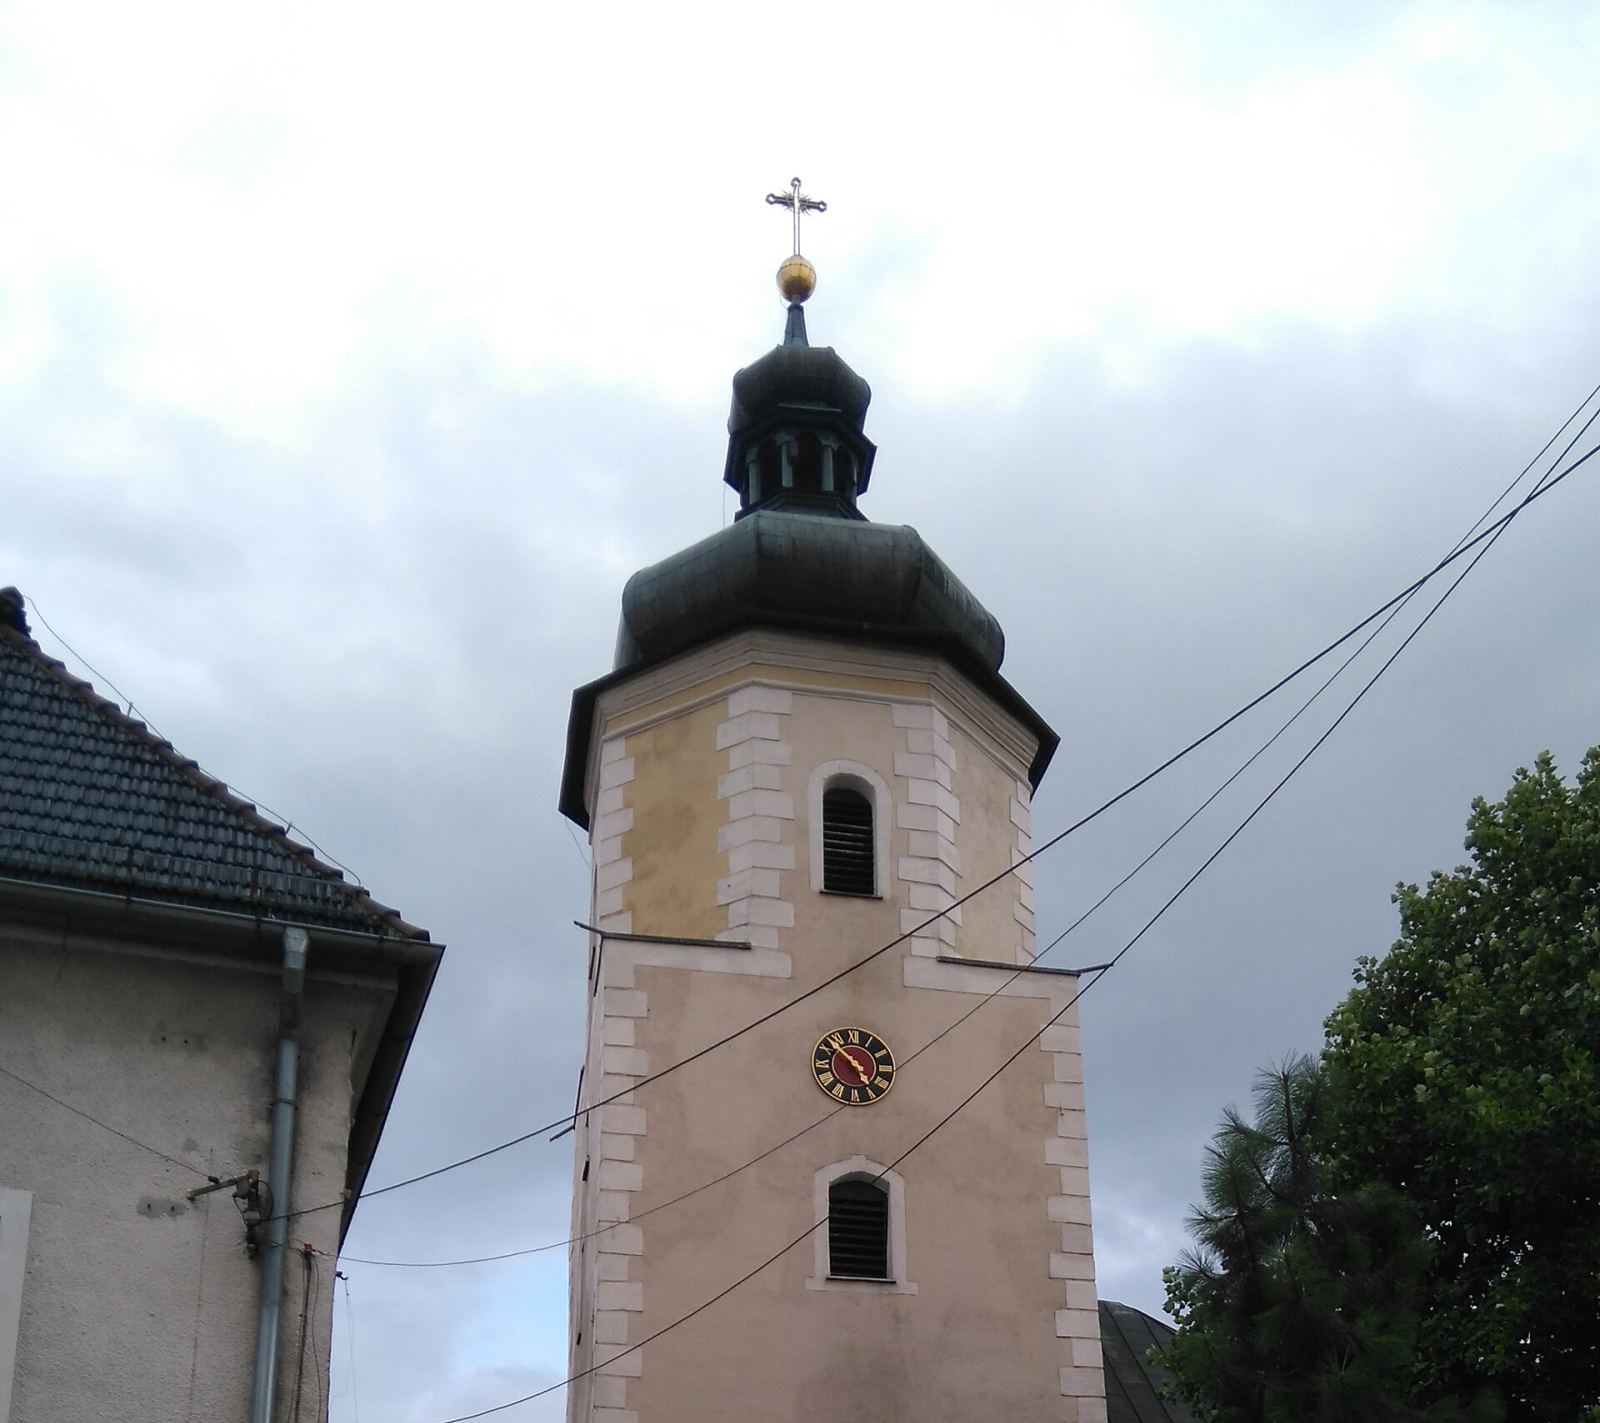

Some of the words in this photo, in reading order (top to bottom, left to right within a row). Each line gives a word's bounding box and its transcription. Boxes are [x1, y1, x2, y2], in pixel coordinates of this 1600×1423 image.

[865, 1036, 873, 1047] I
[819, 1043, 833, 1055] X
[874, 1049, 887, 1058] II
[866, 1087, 876, 1099] V
